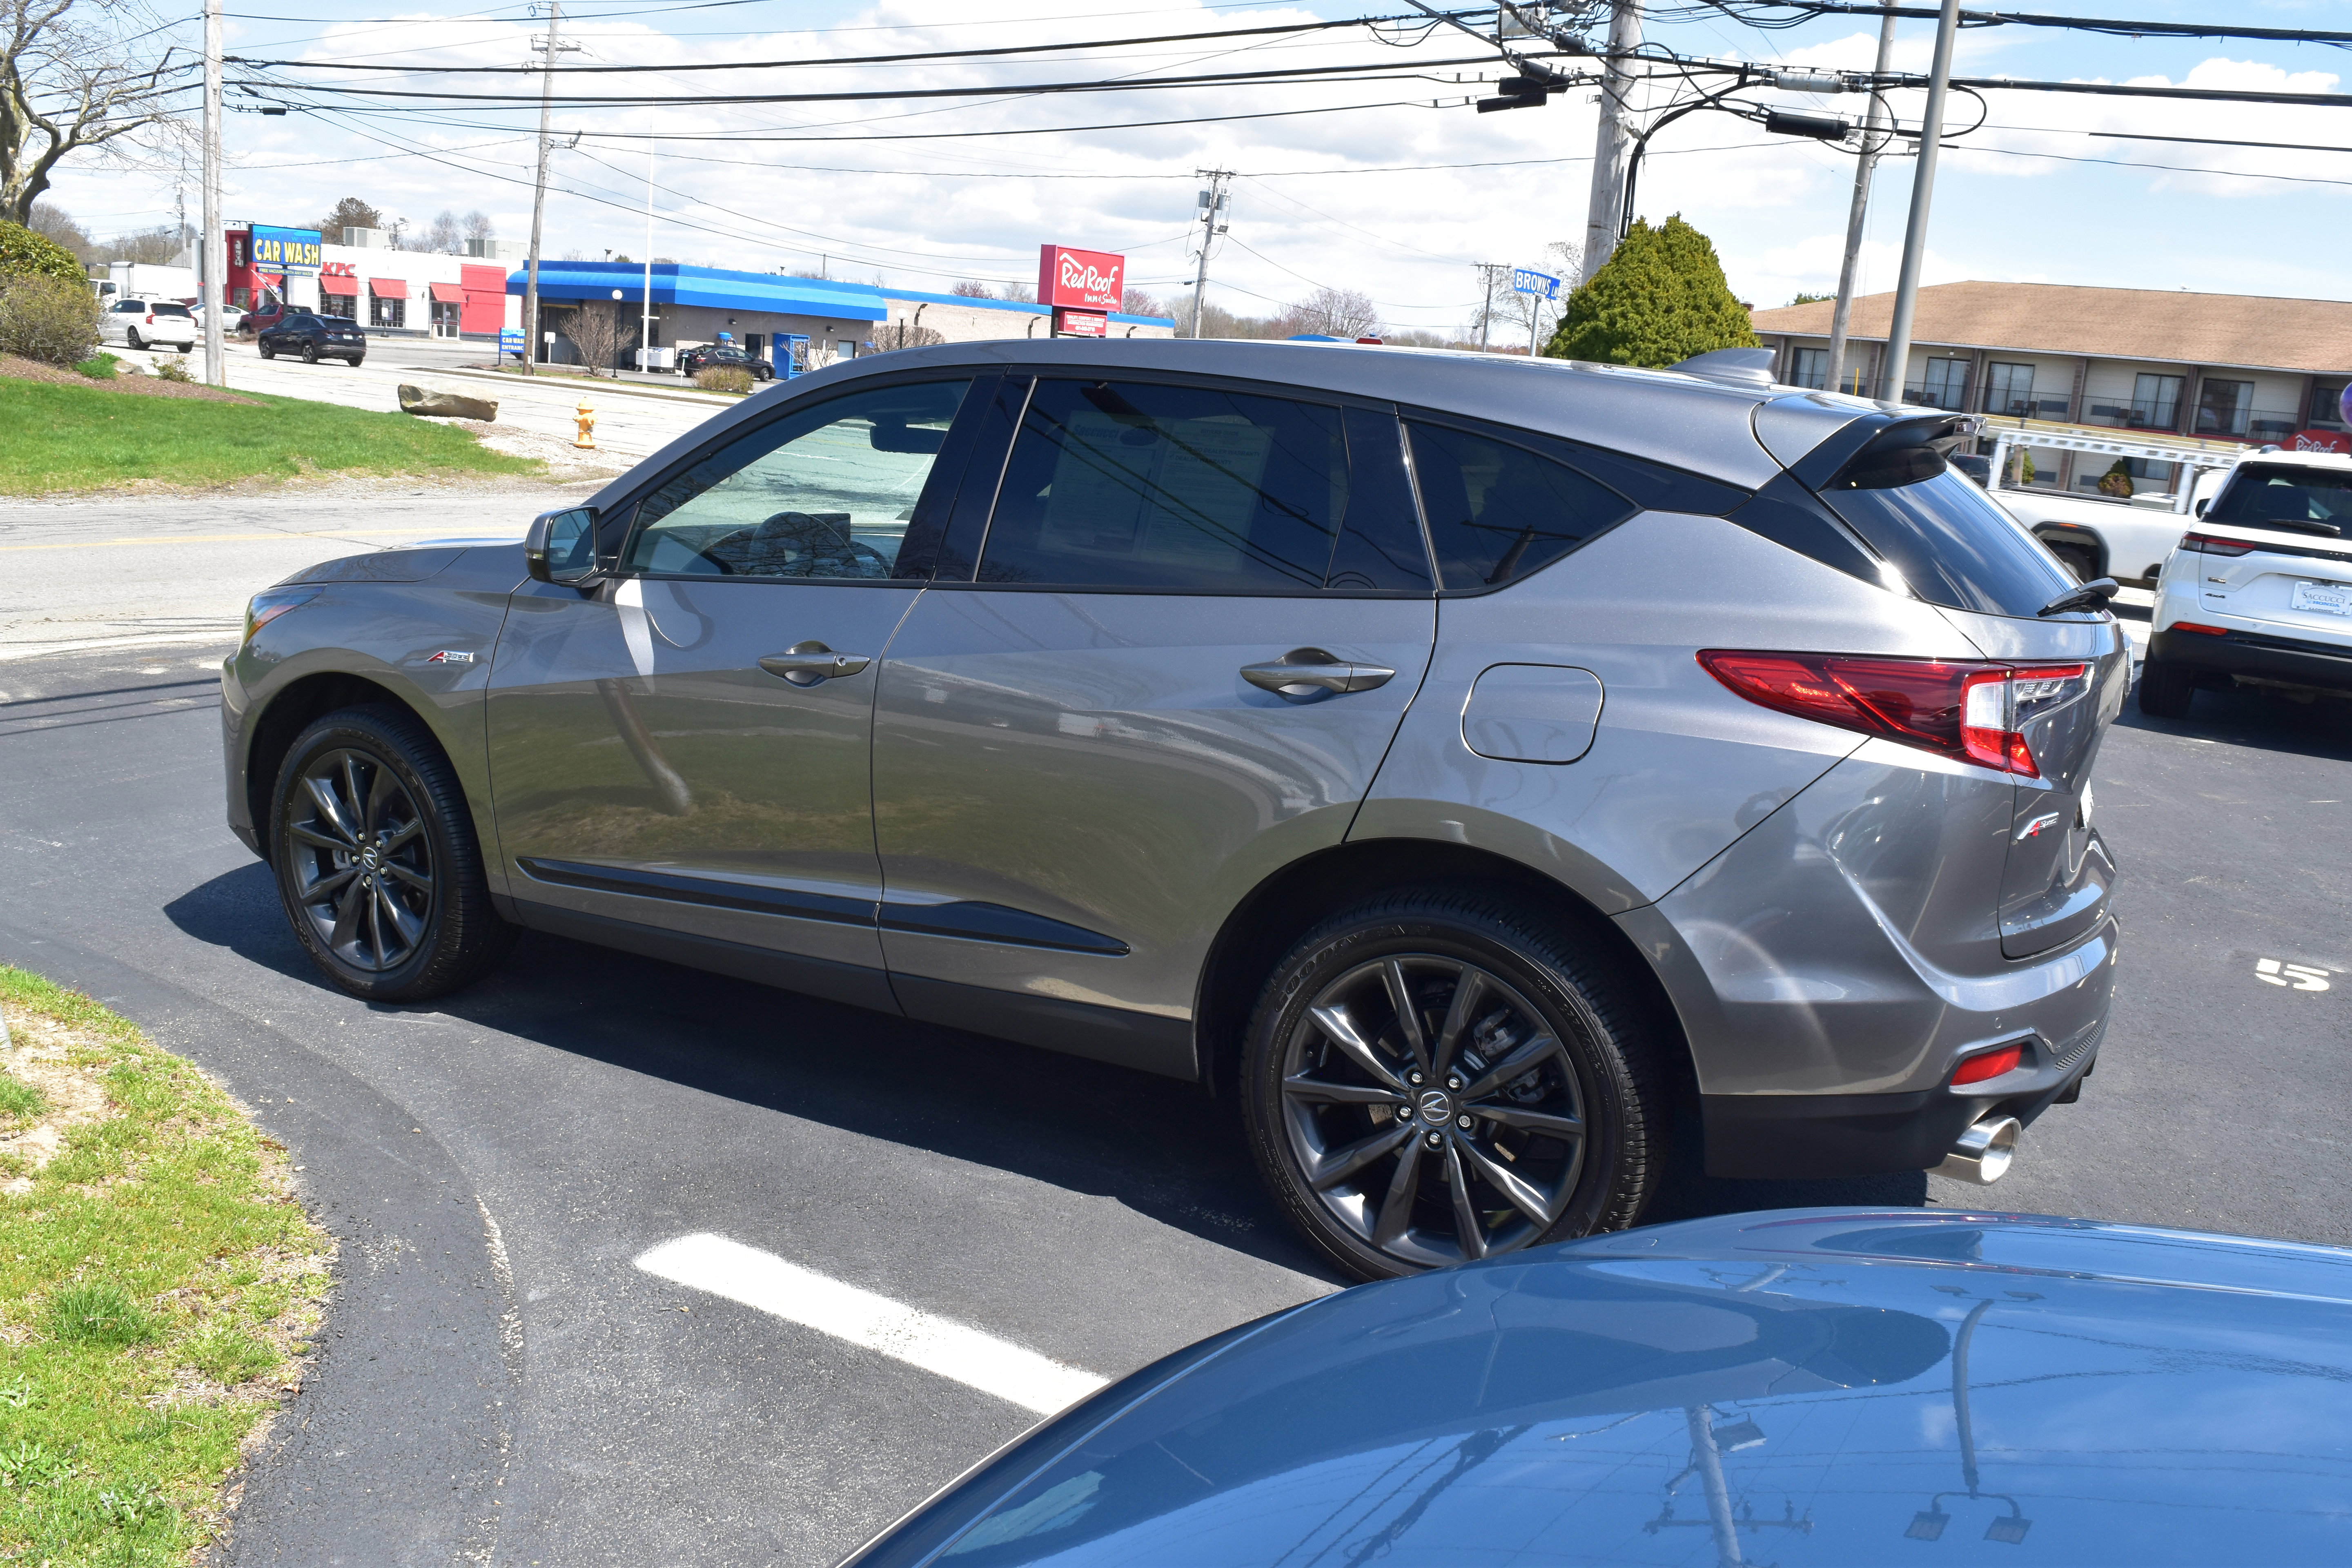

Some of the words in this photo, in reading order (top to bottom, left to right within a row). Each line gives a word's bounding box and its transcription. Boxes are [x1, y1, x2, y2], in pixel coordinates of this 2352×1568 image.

[254, 238, 281, 262] CAR
[284, 241, 320, 266] WASH
[322, 262, 356, 276] KFC
[1516, 272, 1551, 295] BROWNS
[1551, 286, 1559, 298] LN
[1085, 293, 1098, 303] Inn
[1098, 294, 1101, 303] &
[1075, 424, 1120, 438] Saccucci
[2303, 592, 2345, 604] SACCUCCI
[1274, 924, 1430, 1013] GOODYEAR
